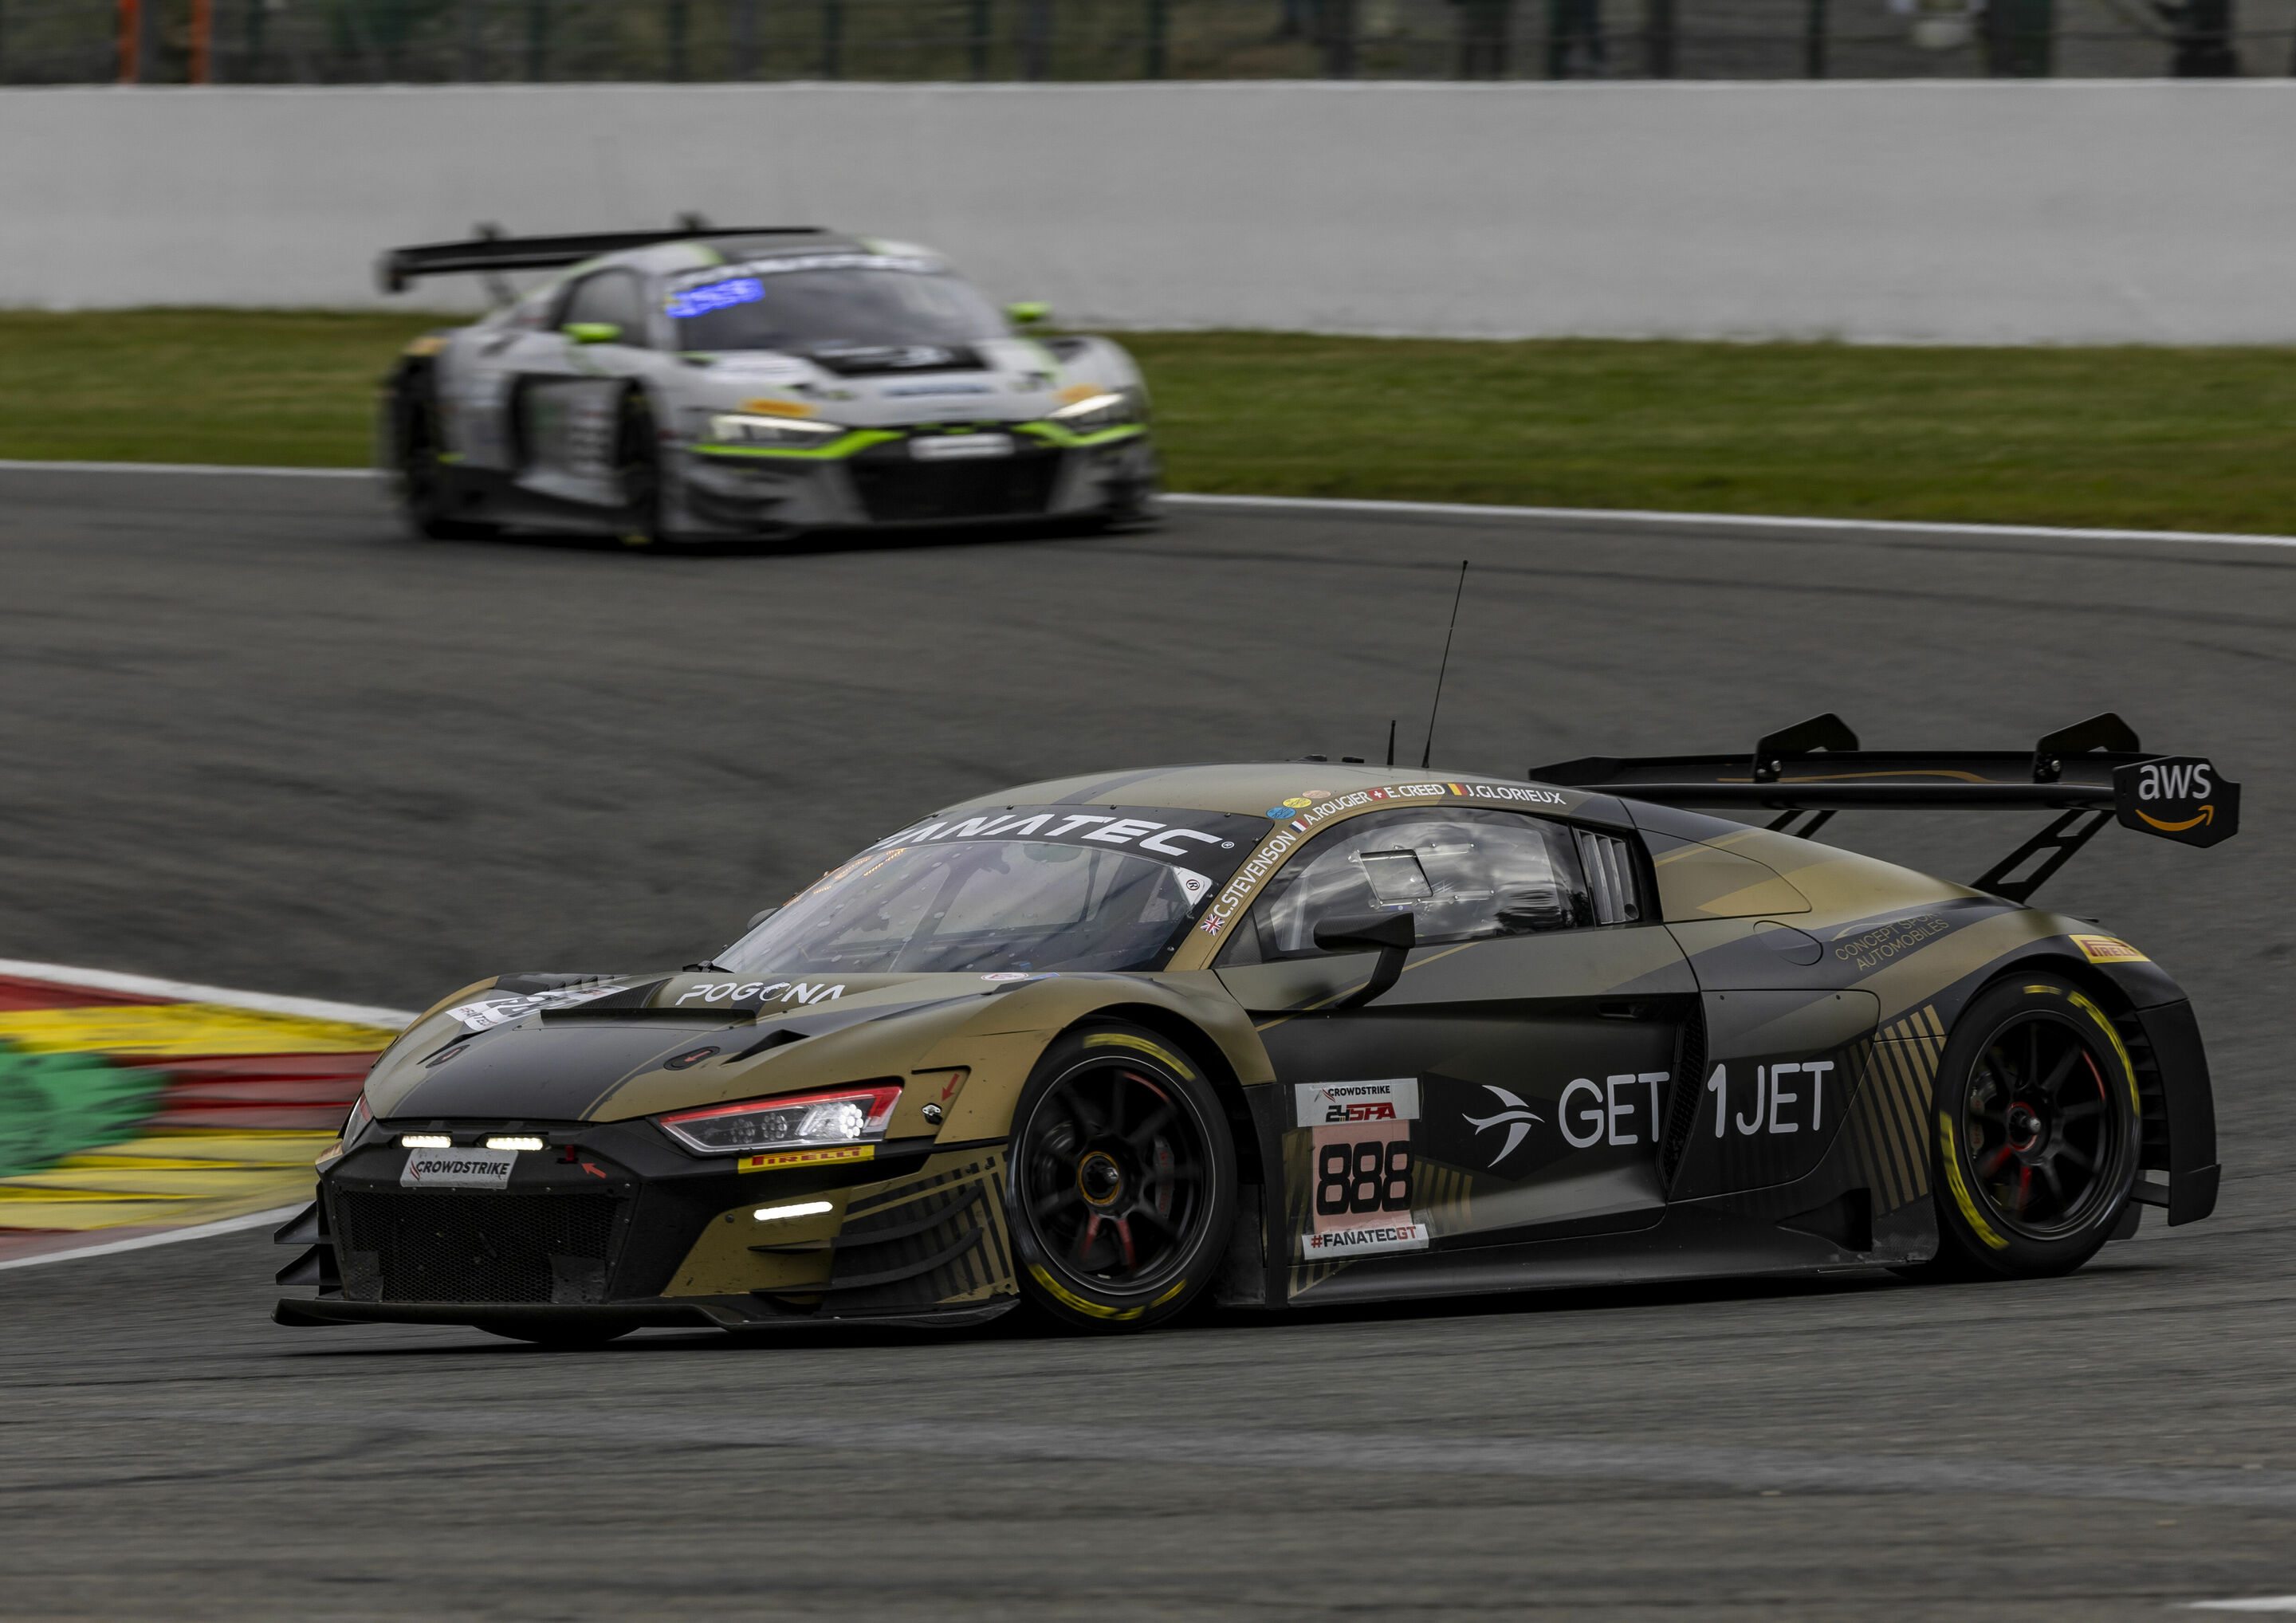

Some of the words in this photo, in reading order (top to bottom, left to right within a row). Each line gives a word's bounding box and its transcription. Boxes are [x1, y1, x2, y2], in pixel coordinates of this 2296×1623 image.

[1465, 784, 1567, 805] J.GLORIEUX
[2138, 763, 2212, 800] aws
[1303, 791, 1373, 826] A.ROUGIER
[1213, 830, 1297, 918] C.STEVENSON
[1835, 925, 1901, 961] CONCEPT
[1857, 919, 1950, 971] AUTOMOBILES
[675, 982, 846, 1006] POGONA
[1327, 1085, 1391, 1097] CROWDSTRIKE
[1558, 1071, 1670, 1149] GET
[415, 1161, 511, 1176] CROWDSTRIKE
[752, 1147, 862, 1166] PIRELLI
[1315, 1141, 1415, 1216] 888
[1311, 1225, 1417, 1249] #FANATECGT
